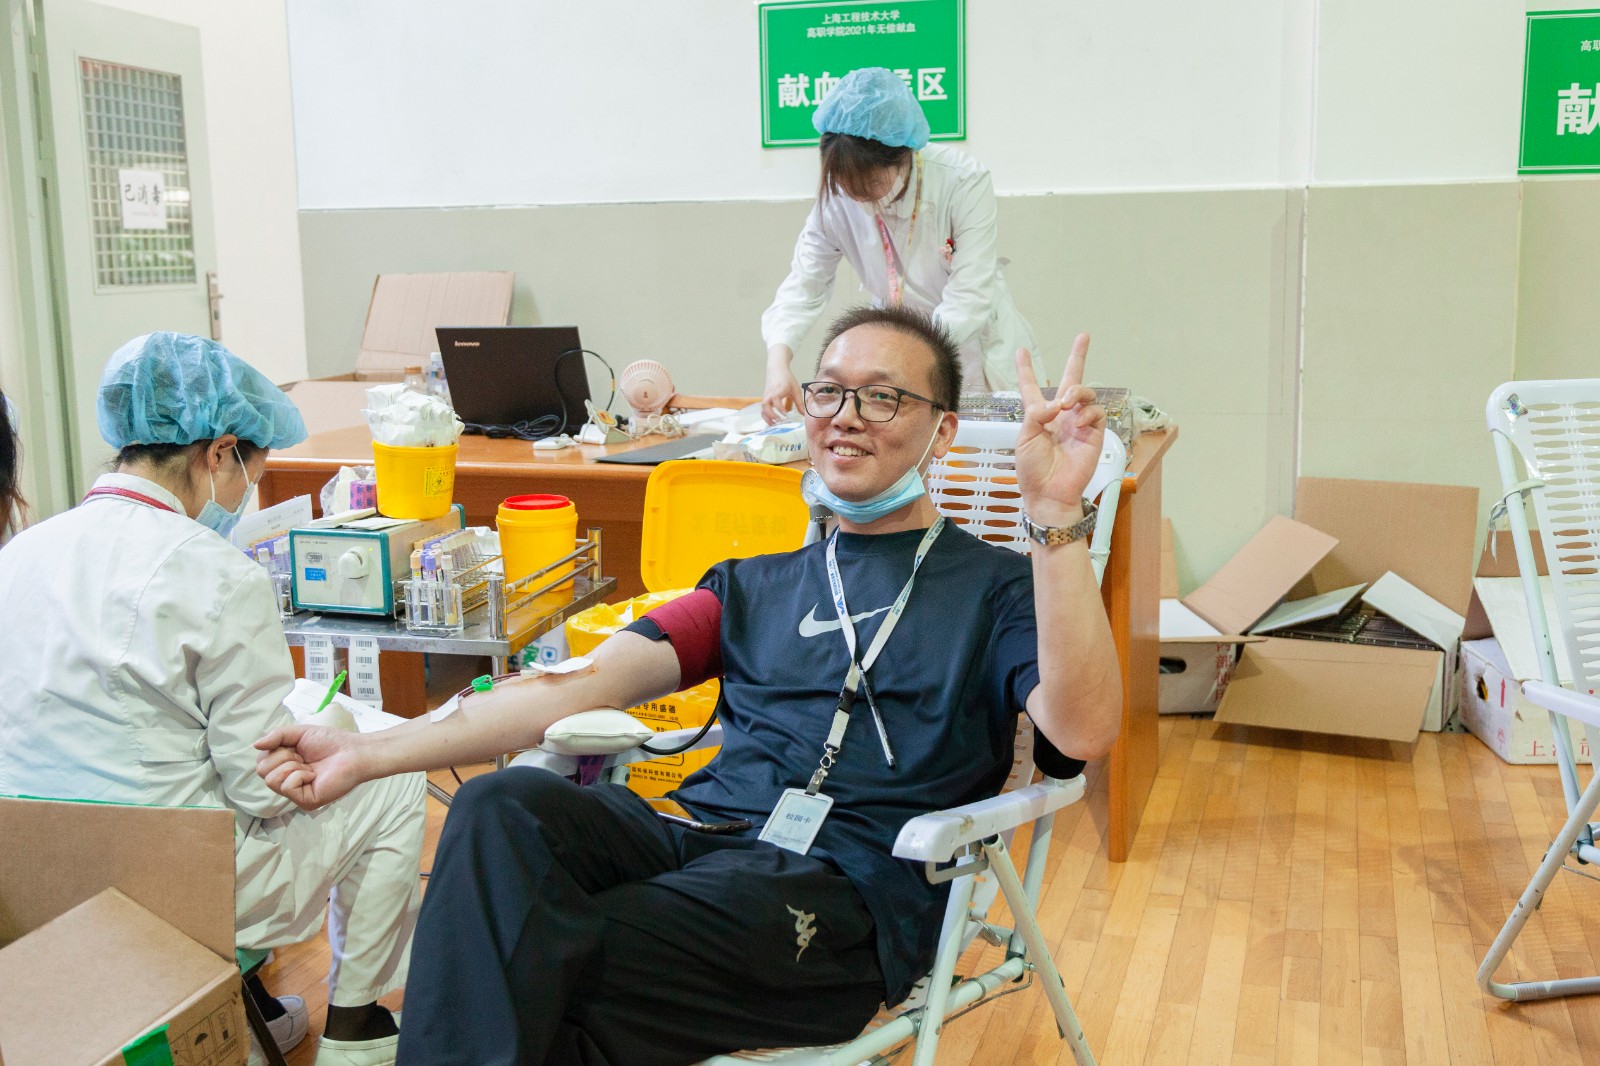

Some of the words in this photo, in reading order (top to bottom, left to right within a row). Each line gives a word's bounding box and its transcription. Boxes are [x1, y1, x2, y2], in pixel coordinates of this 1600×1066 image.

[822, 9, 900, 25] 上海工程技术大学
[806, 22, 916, 38] 高职学院2021年无偿献血
[777, 67, 948, 108] 献血区
